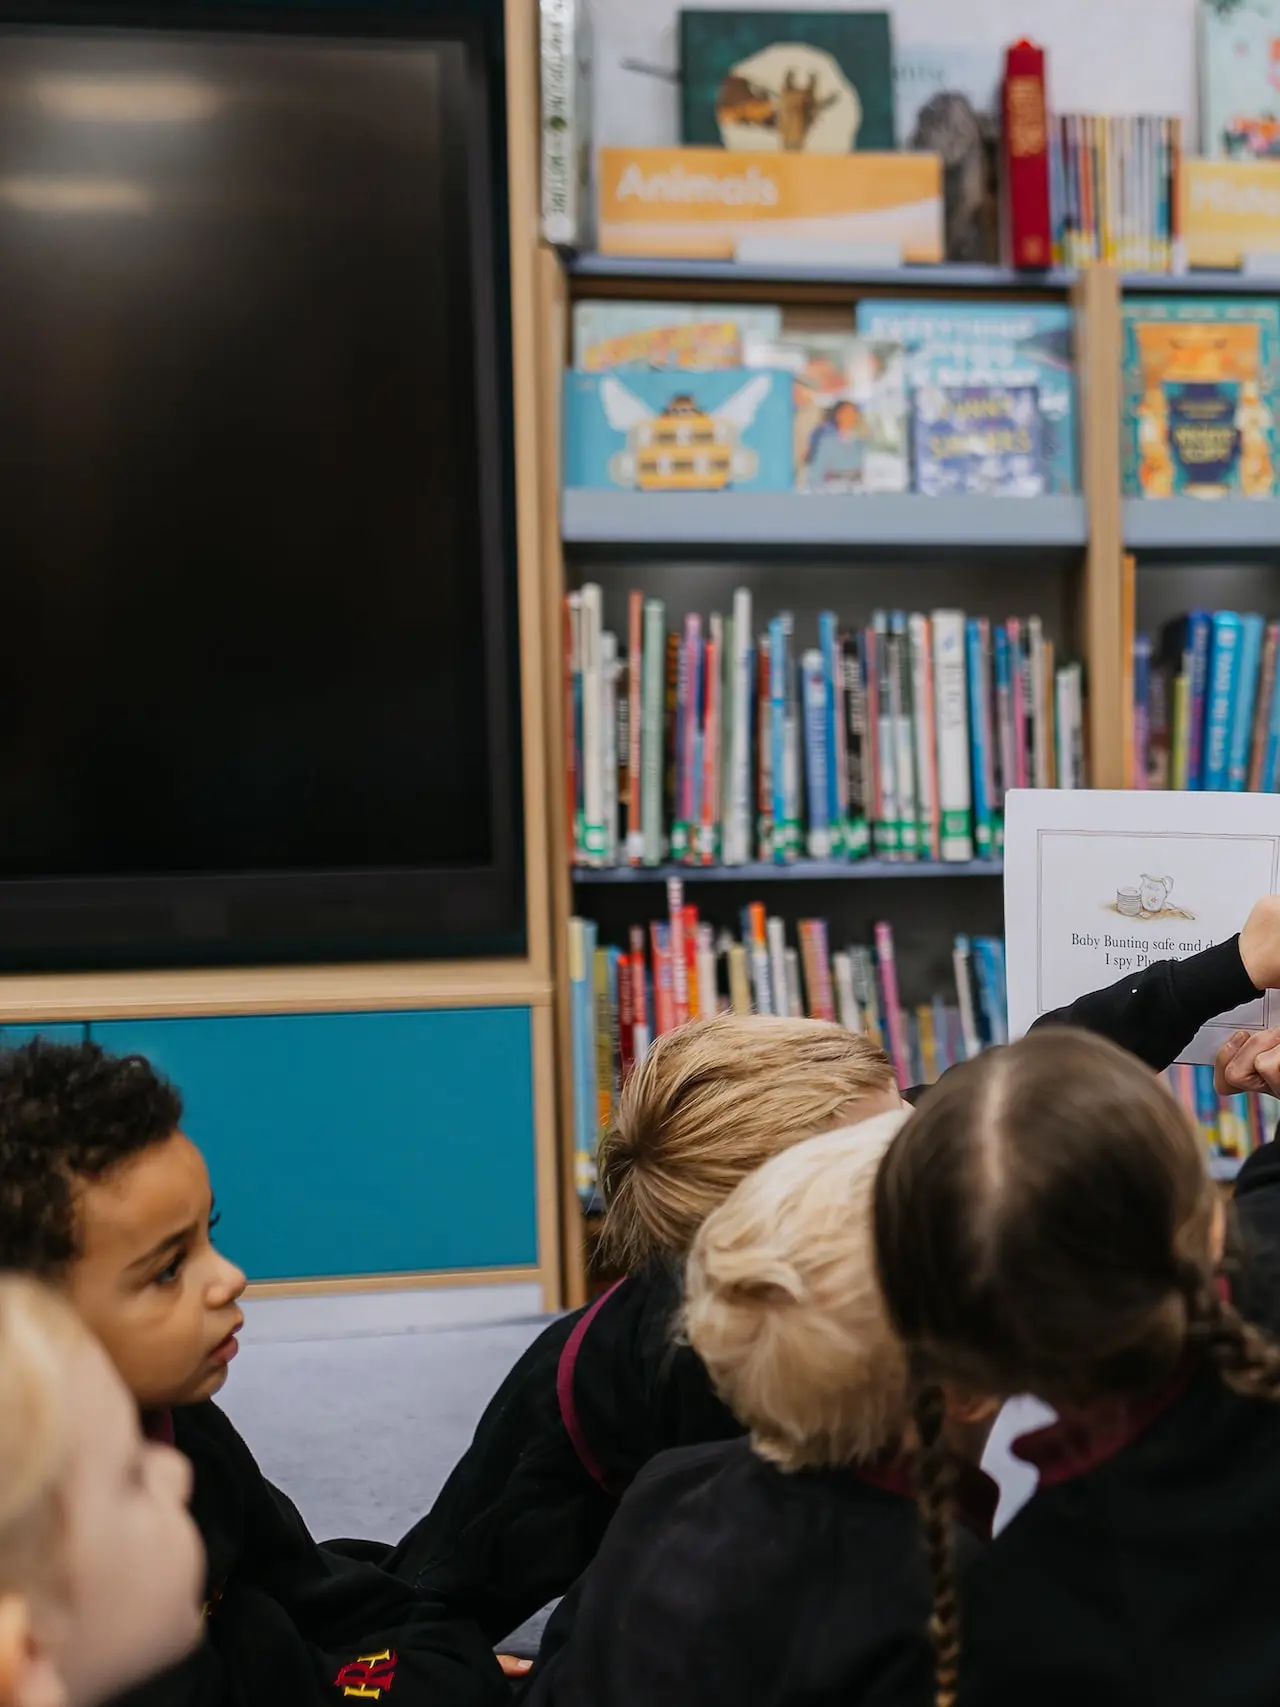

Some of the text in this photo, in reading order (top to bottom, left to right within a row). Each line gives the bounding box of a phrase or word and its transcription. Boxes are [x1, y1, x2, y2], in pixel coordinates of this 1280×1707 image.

[616, 161, 779, 206] Animals
[1072, 933, 1100, 950] Baby
[1104, 935, 1149, 951] Bunting
[1153, 937, 1175, 950] safe
[1179, 940, 1201, 951] and
[1105, 953, 1110, 965] I
[1114, 957, 1132, 969] spy
